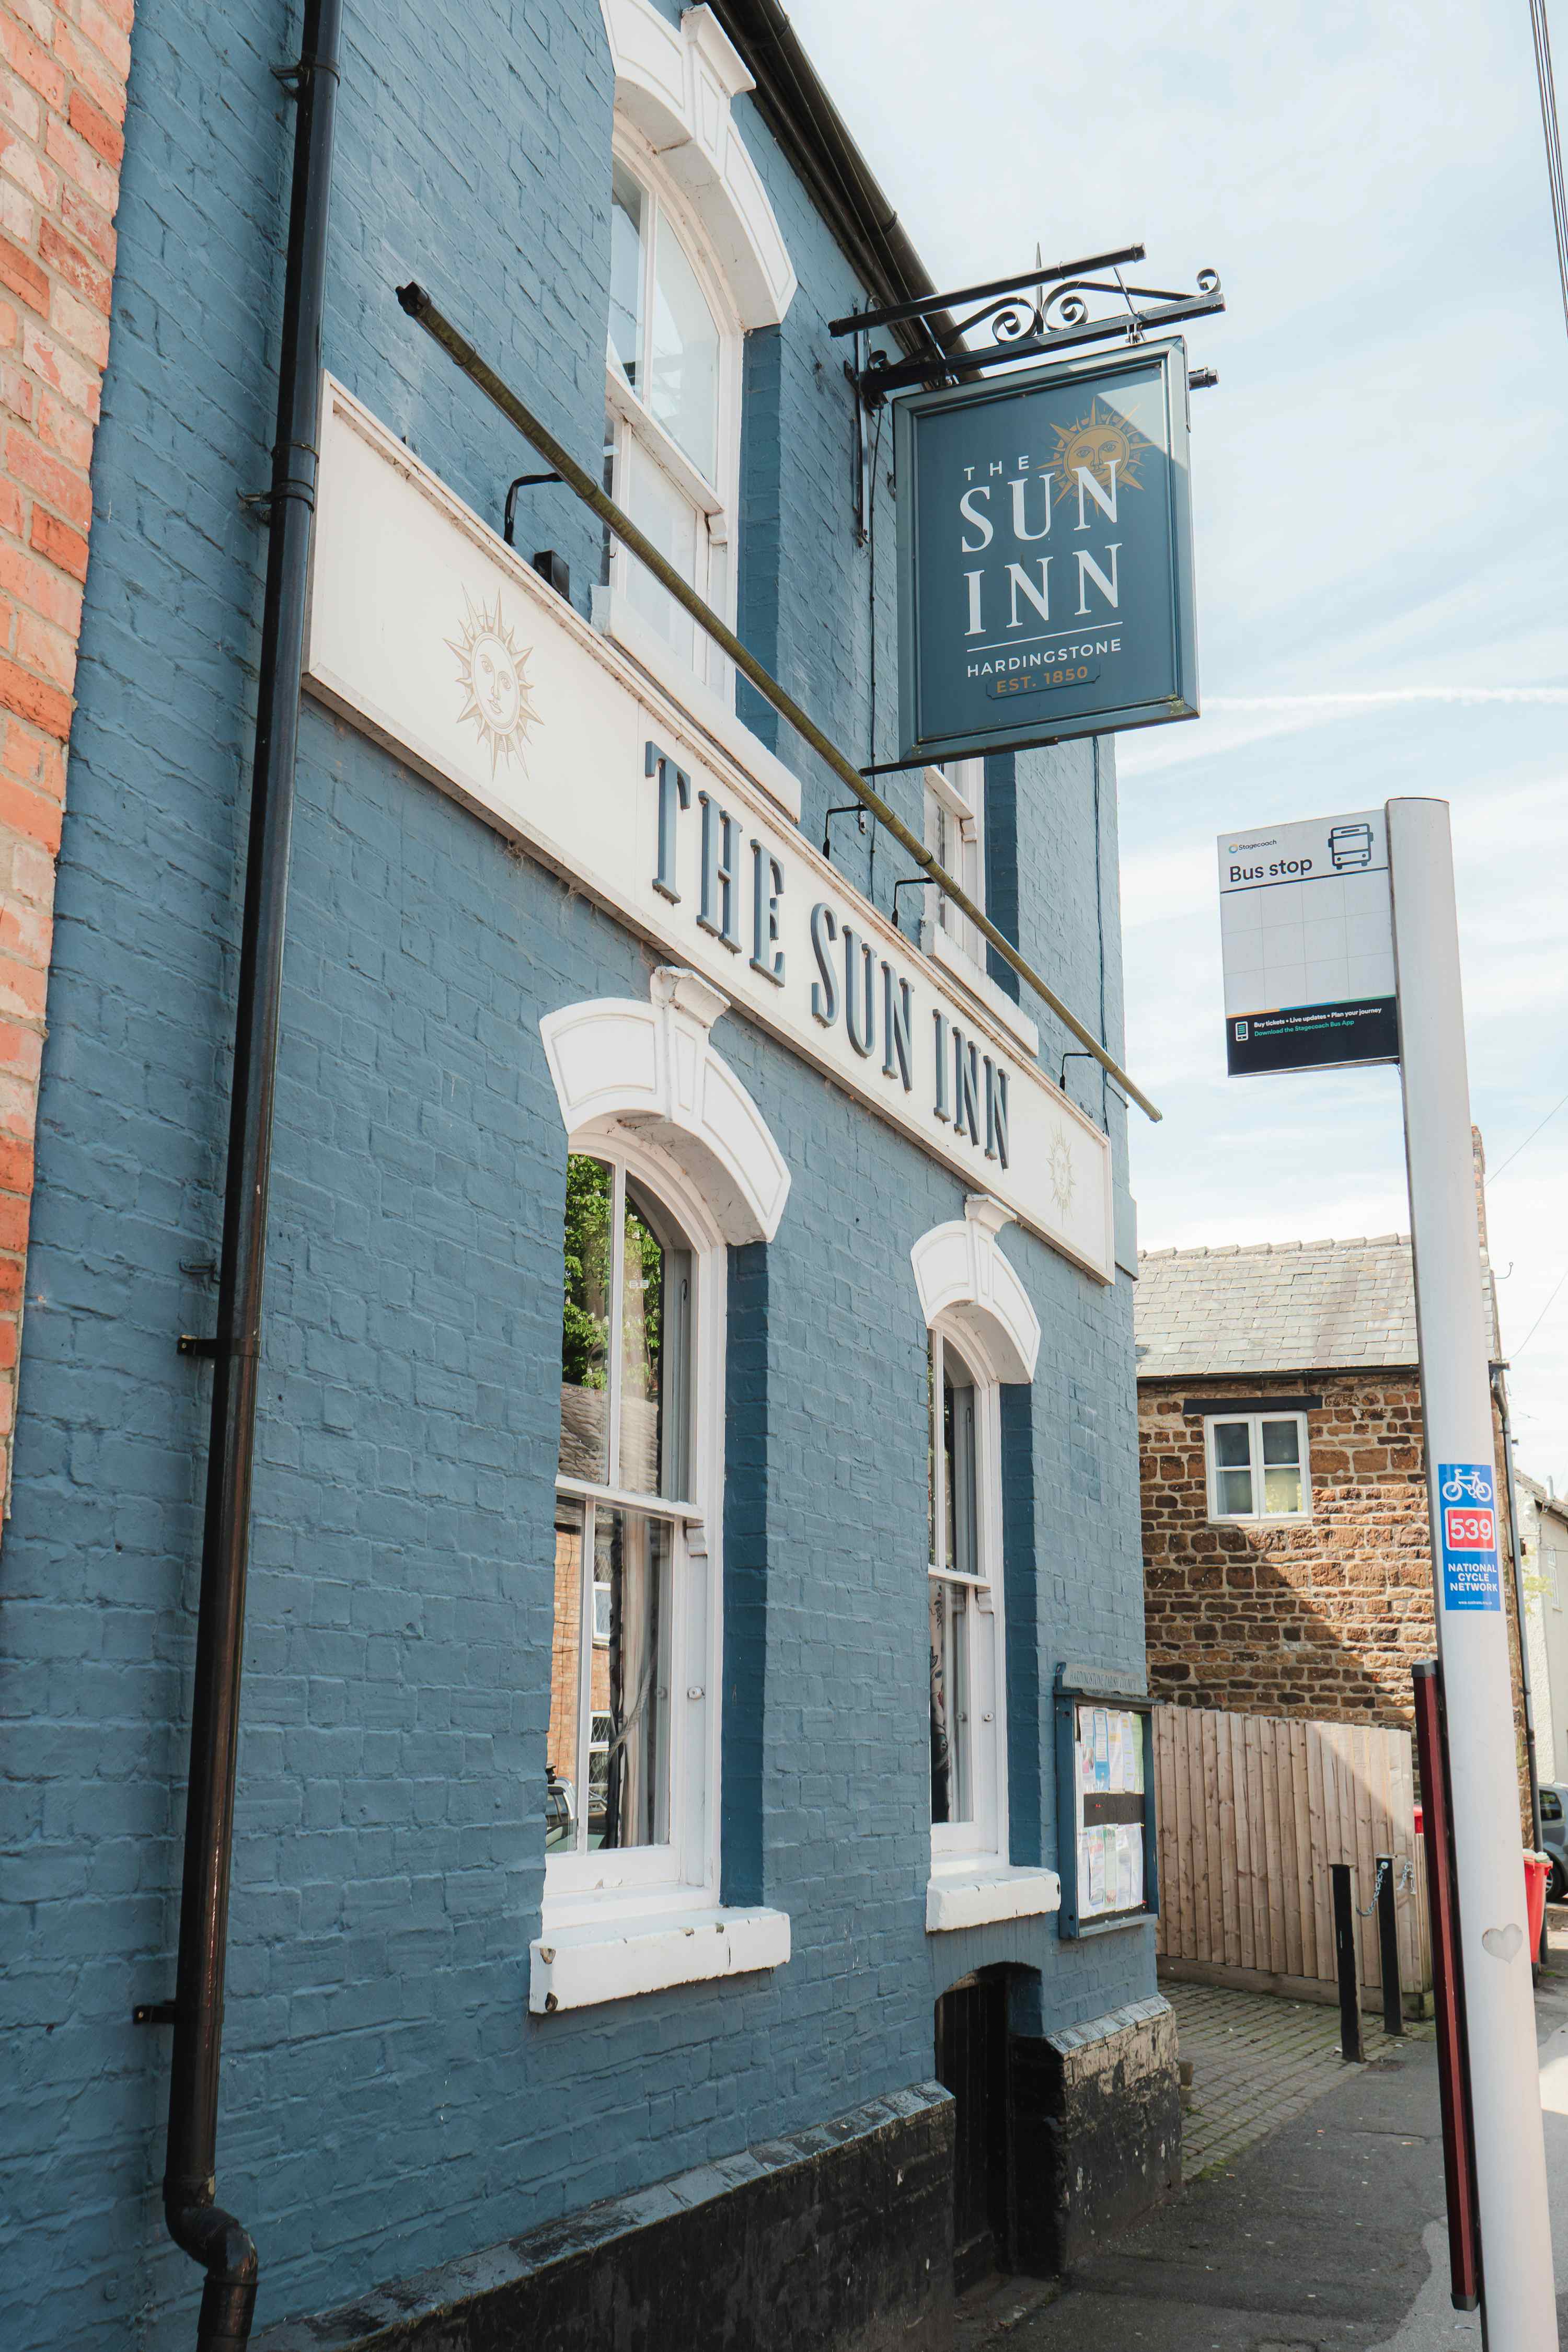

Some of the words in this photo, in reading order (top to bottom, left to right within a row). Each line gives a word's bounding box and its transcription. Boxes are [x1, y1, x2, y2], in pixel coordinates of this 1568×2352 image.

[964, 455, 1029, 481] THE
[960, 458, 1122, 552] SUN
[963, 543, 1123, 636] INN
[967, 638, 1122, 678] HARDINGSTONE
[996, 675, 1037, 694] EST.
[1043, 665, 1088, 685] 1850
[1239, 839, 1277, 850] Stagecoach
[1229, 866, 1264, 882] Bus
[1269, 859, 1313, 876] stop
[644, 740, 786, 988] THE
[810, 902, 915, 1092] SUN
[932, 1008, 1011, 1170] INN
[1302, 1013, 1327, 1023] updates
[1358, 1007, 1382, 1016] journey
[1254, 1028, 1284, 1036] Download
[1295, 1022, 1329, 1032] Stagecoach
[1450, 1518, 1492, 1540] 539
[1448, 1563, 1497, 1573] NATIONAL
[1458, 1573, 1490, 1582] CYCLE
[1450, 1583, 1498, 1592] NETWORK
